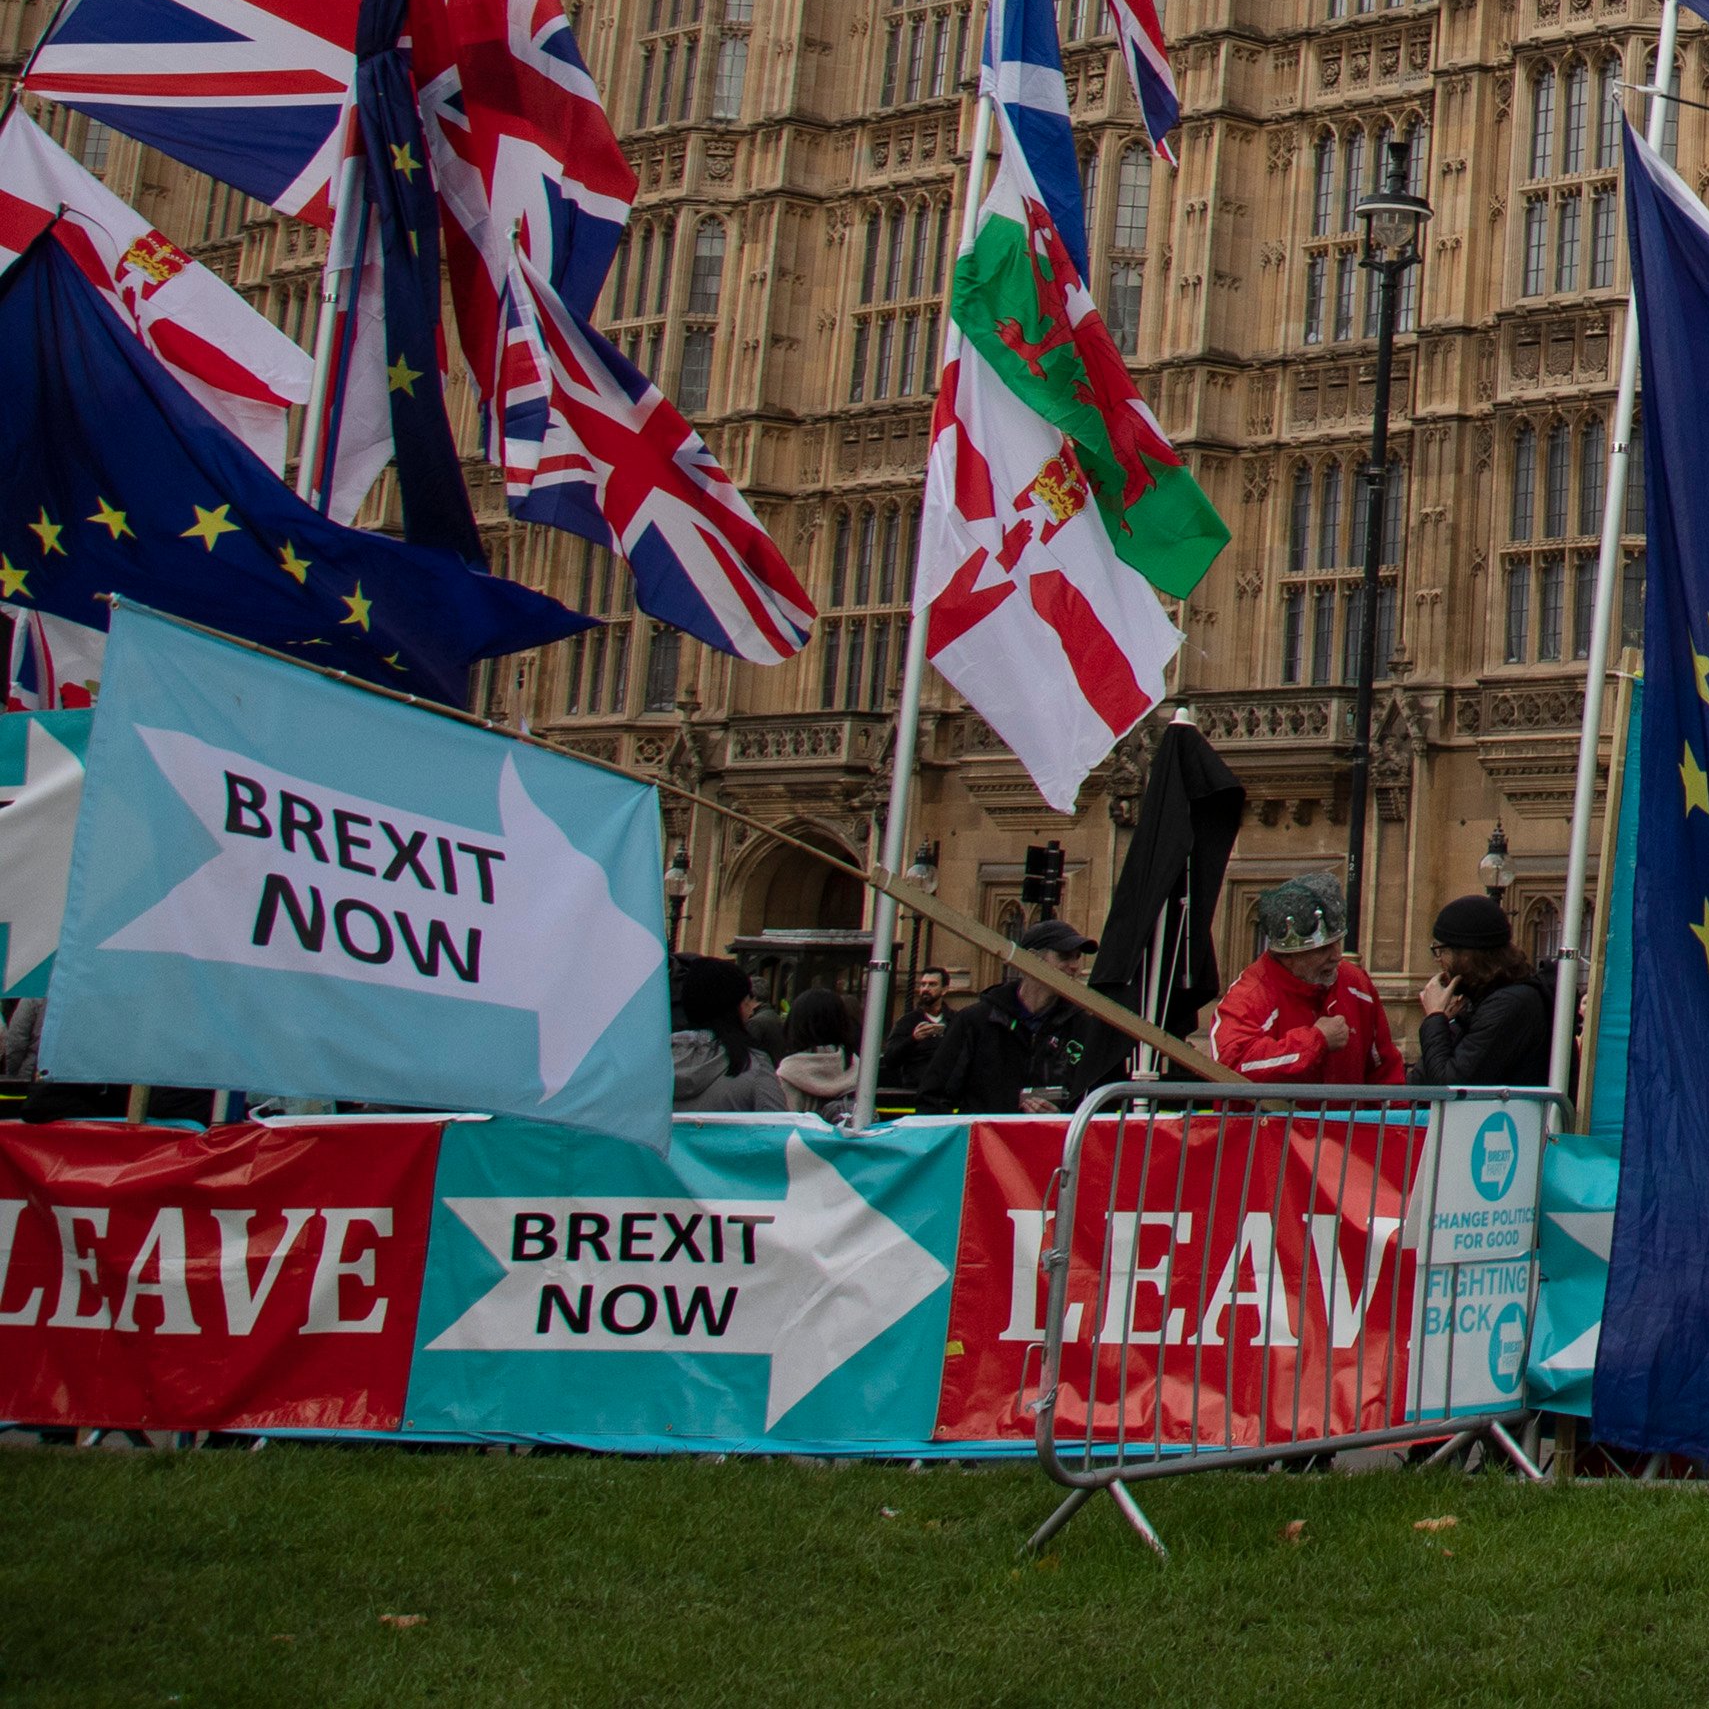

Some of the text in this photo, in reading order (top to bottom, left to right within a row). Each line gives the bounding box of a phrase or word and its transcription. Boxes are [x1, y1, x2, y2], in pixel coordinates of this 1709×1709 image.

[224, 770, 504, 904] BREXIT
[252, 874, 482, 984] NOW
[511, 1212, 775, 1264] BREXIT
[1432, 1207, 1535, 1229] CHANGE POLITICS
[1454, 1230, 1519, 1250] FOR GOOD
[999, 1209, 1409, 1348] LEAV
[1427, 1265, 1528, 1298] FIGHTING
[537, 1284, 738, 1338] NOW
